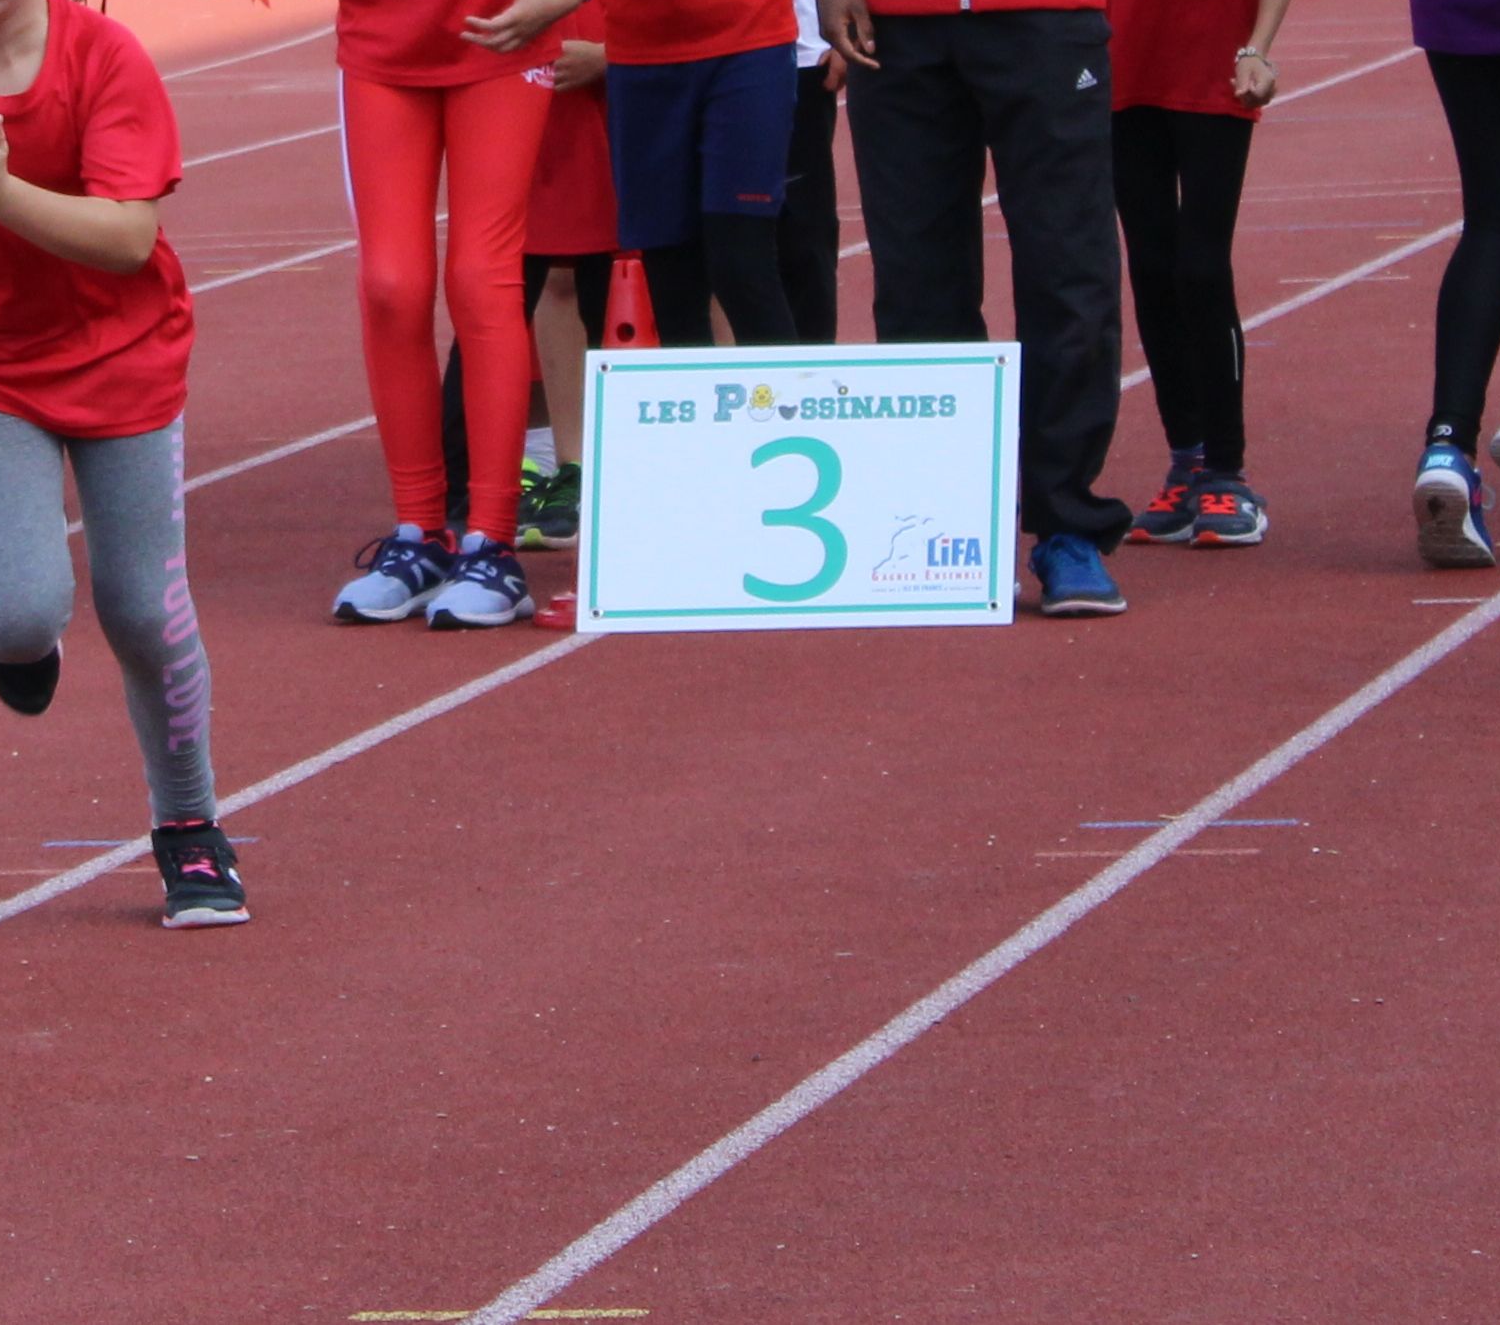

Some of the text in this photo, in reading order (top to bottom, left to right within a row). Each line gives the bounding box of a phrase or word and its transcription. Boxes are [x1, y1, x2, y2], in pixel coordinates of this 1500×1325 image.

[637, 400, 697, 425] LES
[742, 436, 848, 603] 3
[163, 649, 207, 753] LOVE
